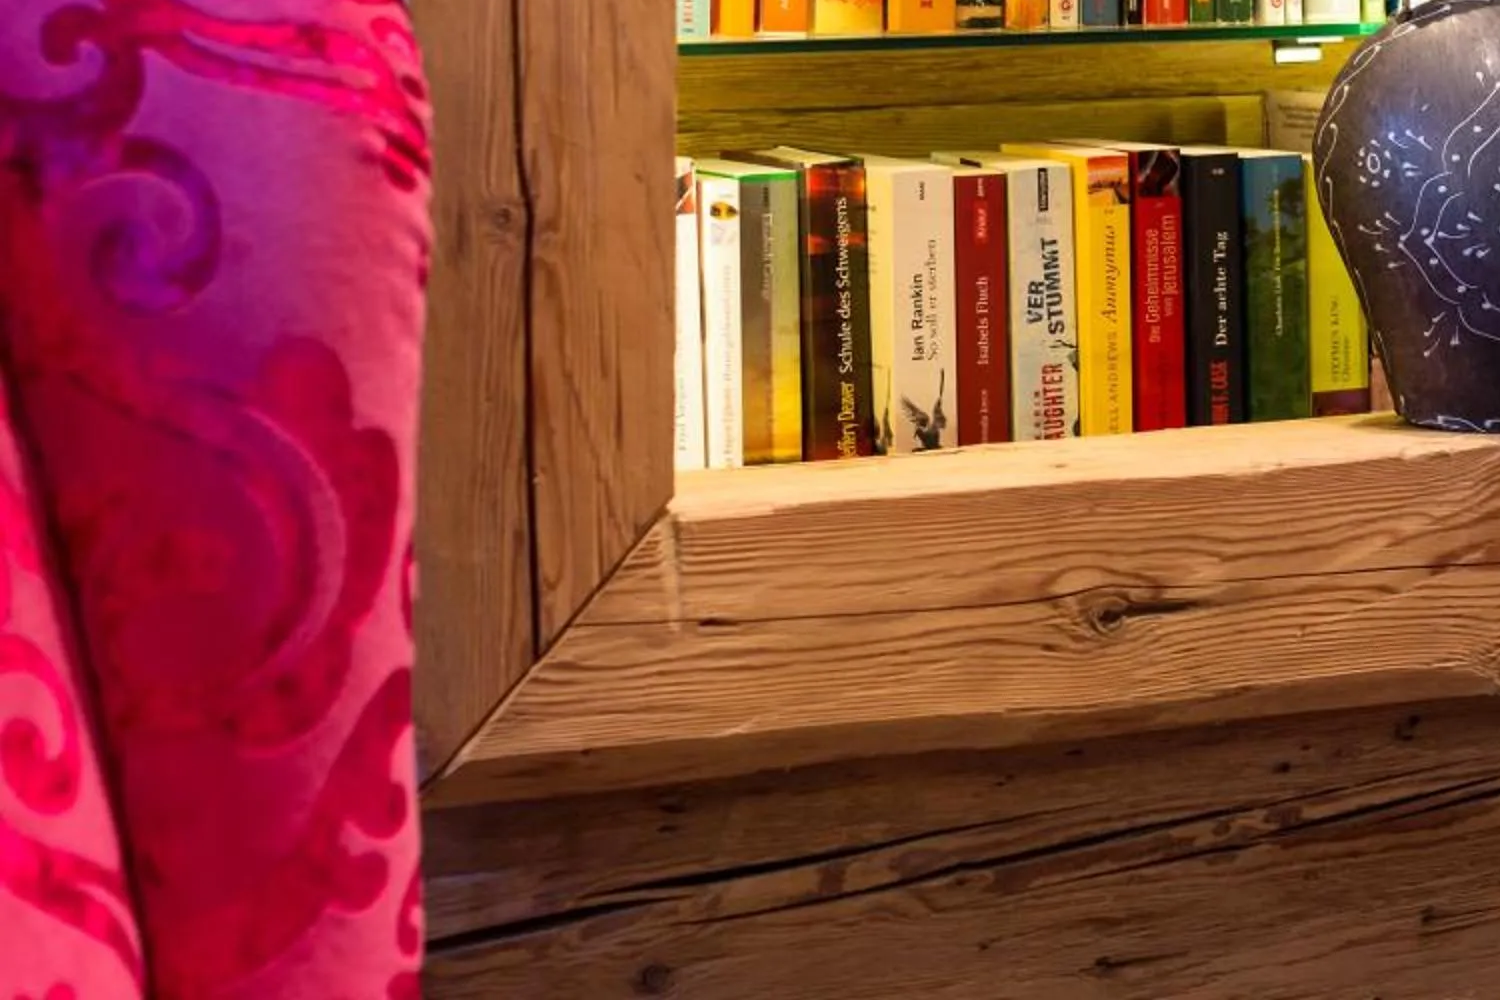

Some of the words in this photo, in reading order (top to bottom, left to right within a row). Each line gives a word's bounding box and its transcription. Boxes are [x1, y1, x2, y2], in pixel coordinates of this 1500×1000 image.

[834, 196, 852, 289] Schweigens
[1212, 230, 1229, 264] Tag
[974, 275, 989, 315] Fluch
[1040, 236, 1065, 336] STUMMT
[1144, 228, 1160, 324] Geheimnisse
[1212, 267, 1227, 312] achte
[836, 291, 852, 321] des
[910, 272, 925, 332] Rankin
[1025, 280, 1045, 325] VER
[837, 322, 854, 375] Schule
[911, 334, 926, 362] Ian
[976, 316, 990, 366] Isabels
[1214, 315, 1228, 346] Der
[1041, 362, 1065, 441] AUGHTER
[837, 421, 860, 459] effery
